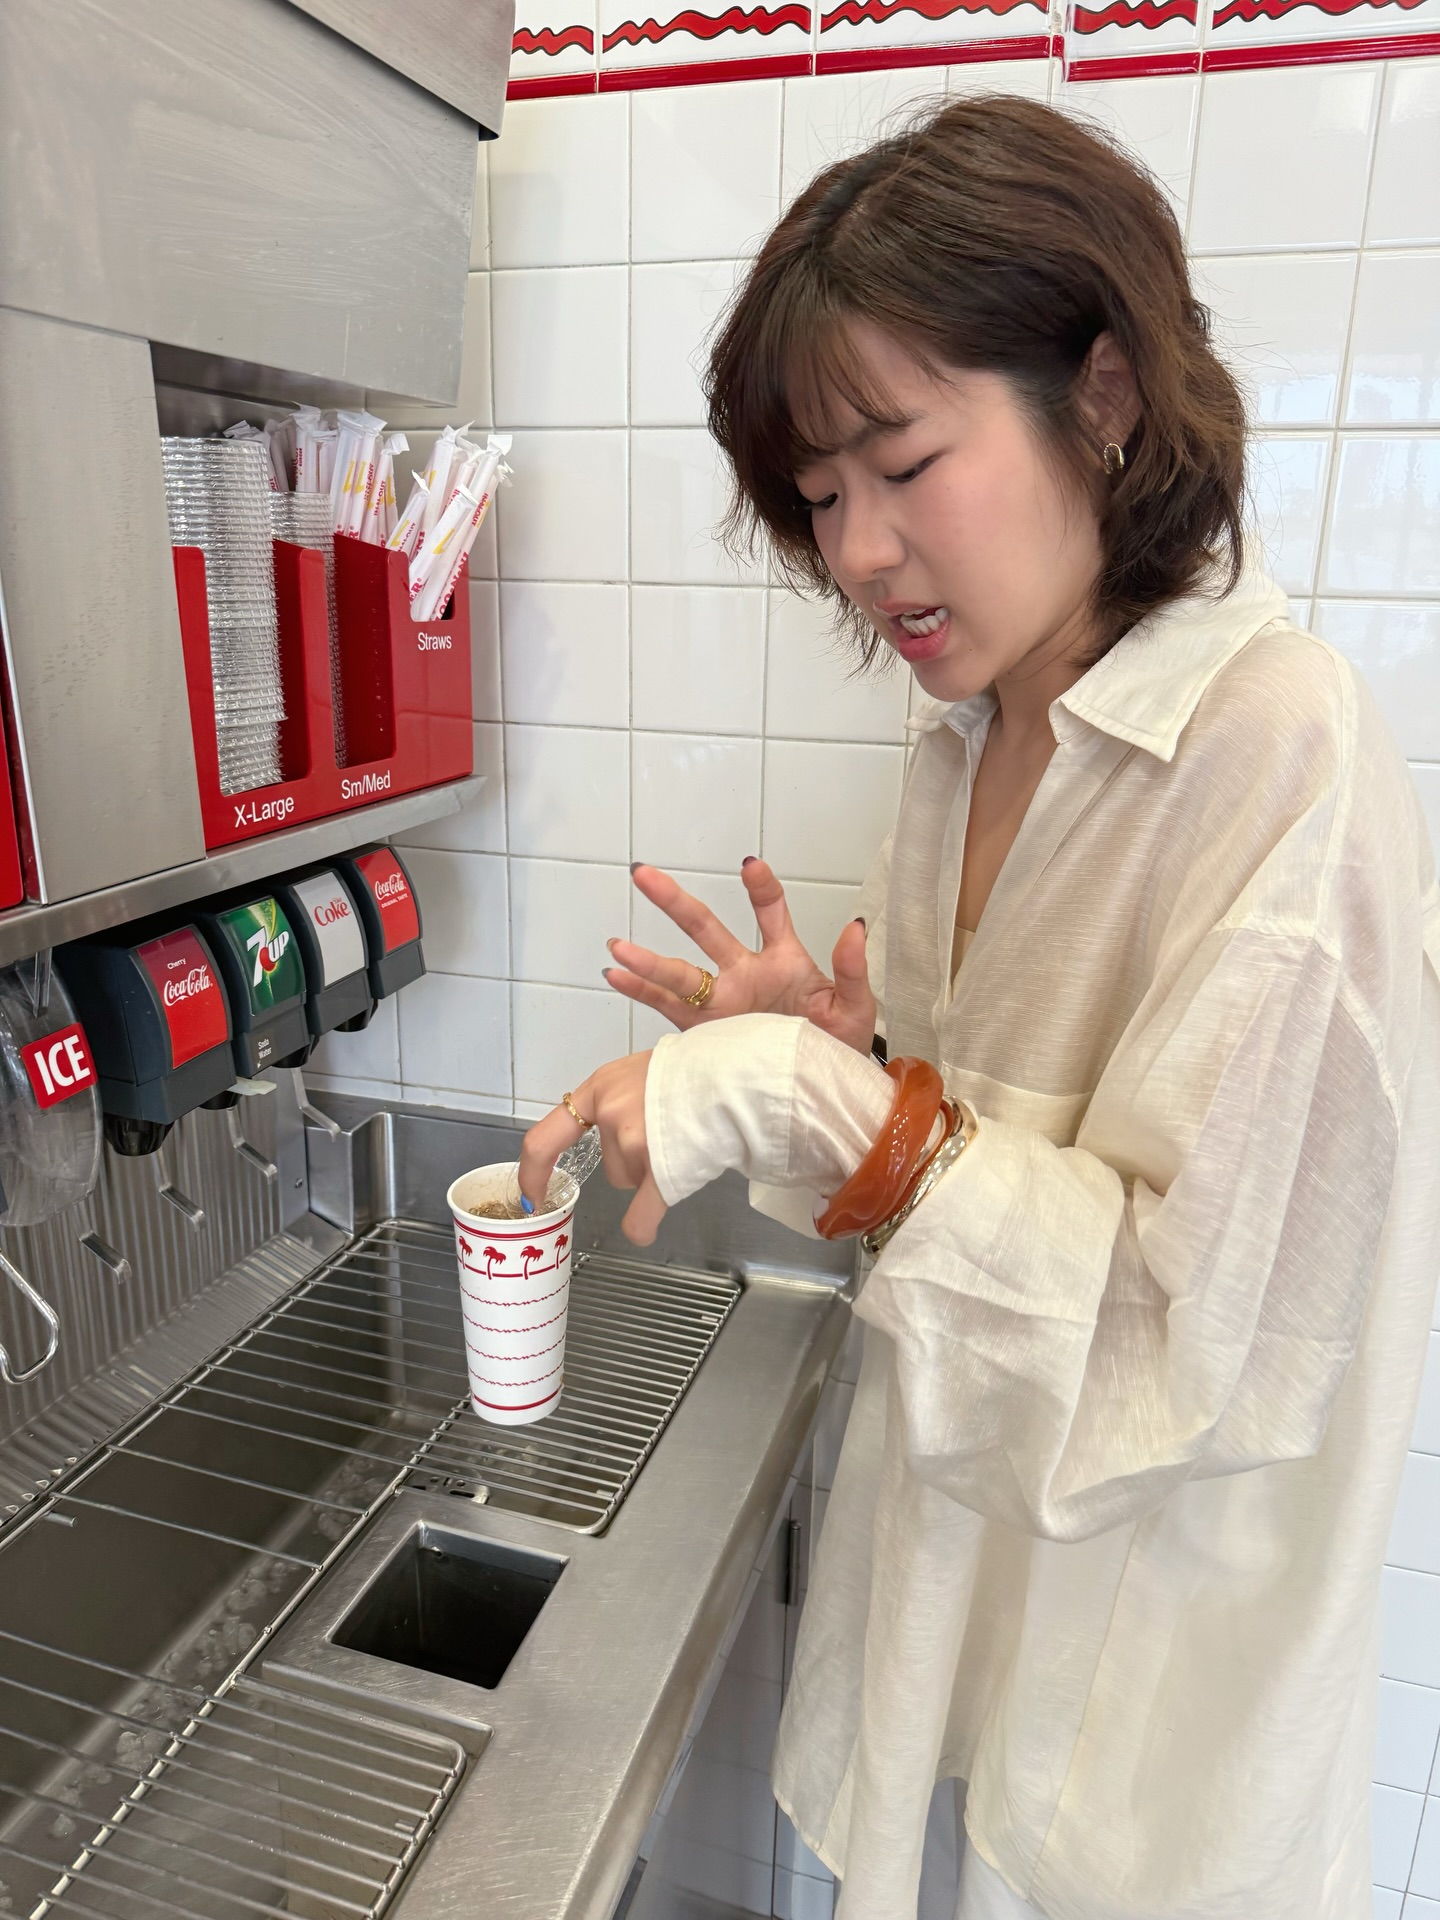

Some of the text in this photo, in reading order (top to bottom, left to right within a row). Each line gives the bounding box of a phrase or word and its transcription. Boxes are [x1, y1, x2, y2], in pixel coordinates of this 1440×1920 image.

[417, 632, 452, 651] Straws
[341, 769, 391, 800] Sm/Med
[234, 796, 295, 828] X-Large
[375, 872, 405, 901] Coca-Cola
[314, 901, 350, 927] Coke
[167, 957, 187, 970] Cherry
[163, 964, 210, 1007] Coca-Cola
[257, 1038, 270, 1050] Soda
[258, 1047, 272, 1059] Water
[33, 1034, 91, 1096] ICE
